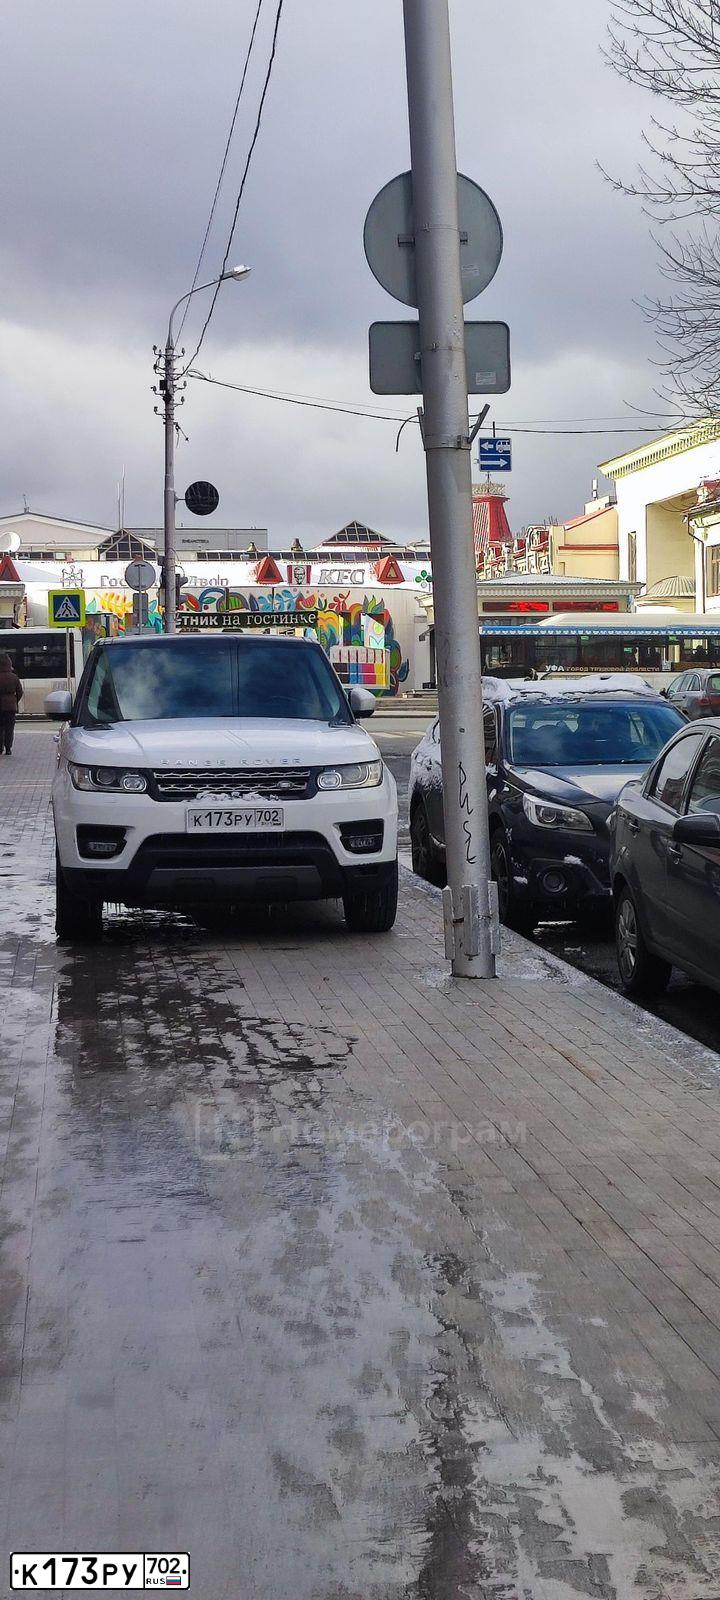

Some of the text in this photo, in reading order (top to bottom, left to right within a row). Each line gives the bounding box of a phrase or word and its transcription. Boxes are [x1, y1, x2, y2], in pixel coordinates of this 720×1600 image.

[318, 569, 365, 584] KFC
[222, 615, 241, 626] на
[193, 810, 279, 826] К173РУ 702
